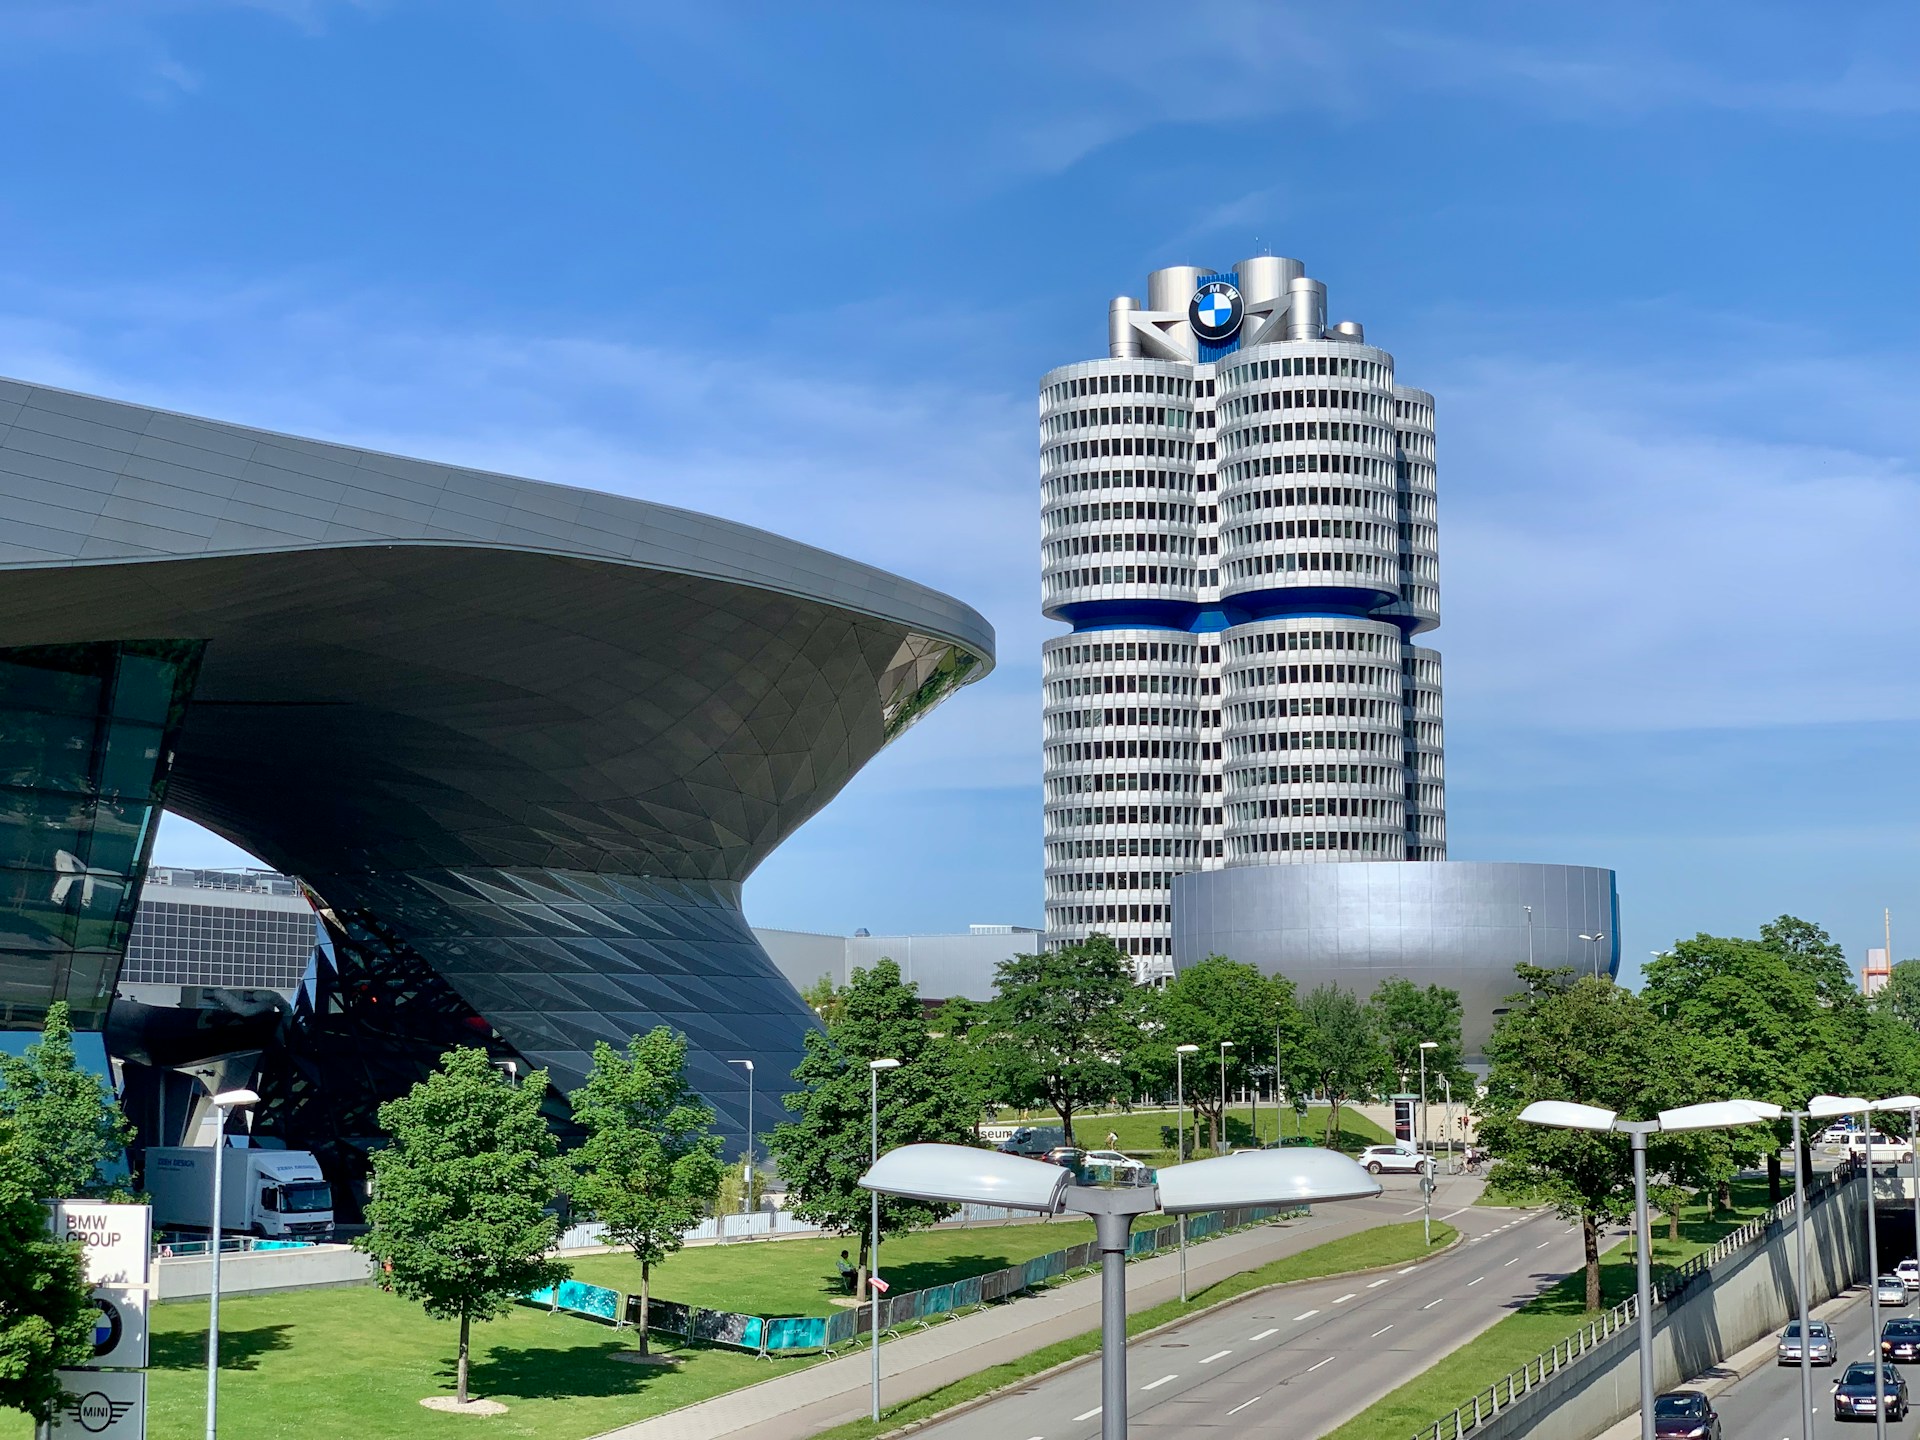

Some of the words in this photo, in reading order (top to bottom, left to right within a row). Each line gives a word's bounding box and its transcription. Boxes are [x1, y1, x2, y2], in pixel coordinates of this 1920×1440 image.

[1193, 283, 1238, 303] BMW
[66, 1214, 107, 1230] BMW
[66, 1231, 122, 1247] GROUP
[83, 1406, 108, 1418] MINI
